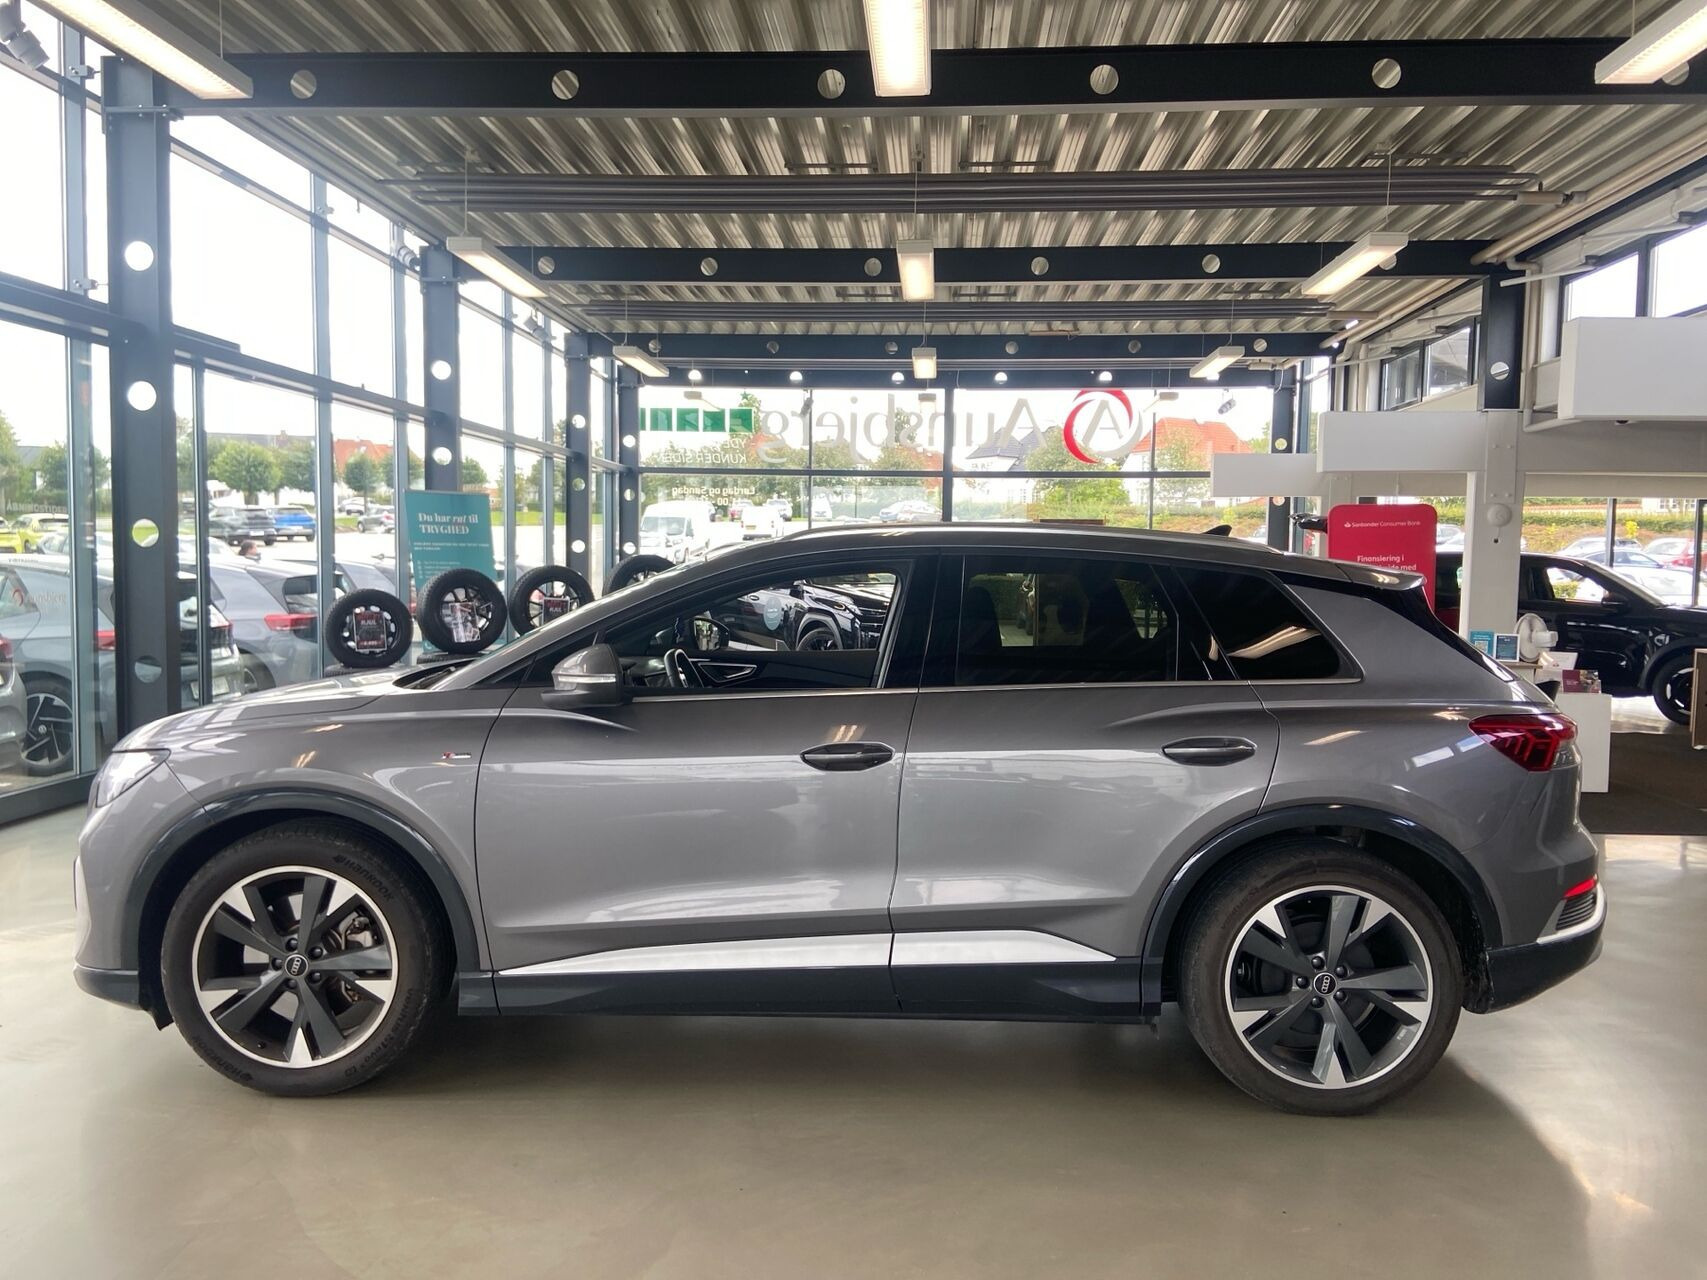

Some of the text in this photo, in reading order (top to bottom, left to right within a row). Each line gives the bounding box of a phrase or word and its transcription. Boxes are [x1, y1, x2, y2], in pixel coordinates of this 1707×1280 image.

[418, 512, 433, 522] Du
[434, 512, 451, 523] har
[468, 514, 479, 524] til
[418, 524, 470, 535] TRYGHED
[1351, 521, 1379, 529] Santander
[1356, 554, 1401, 563] Finansiering
